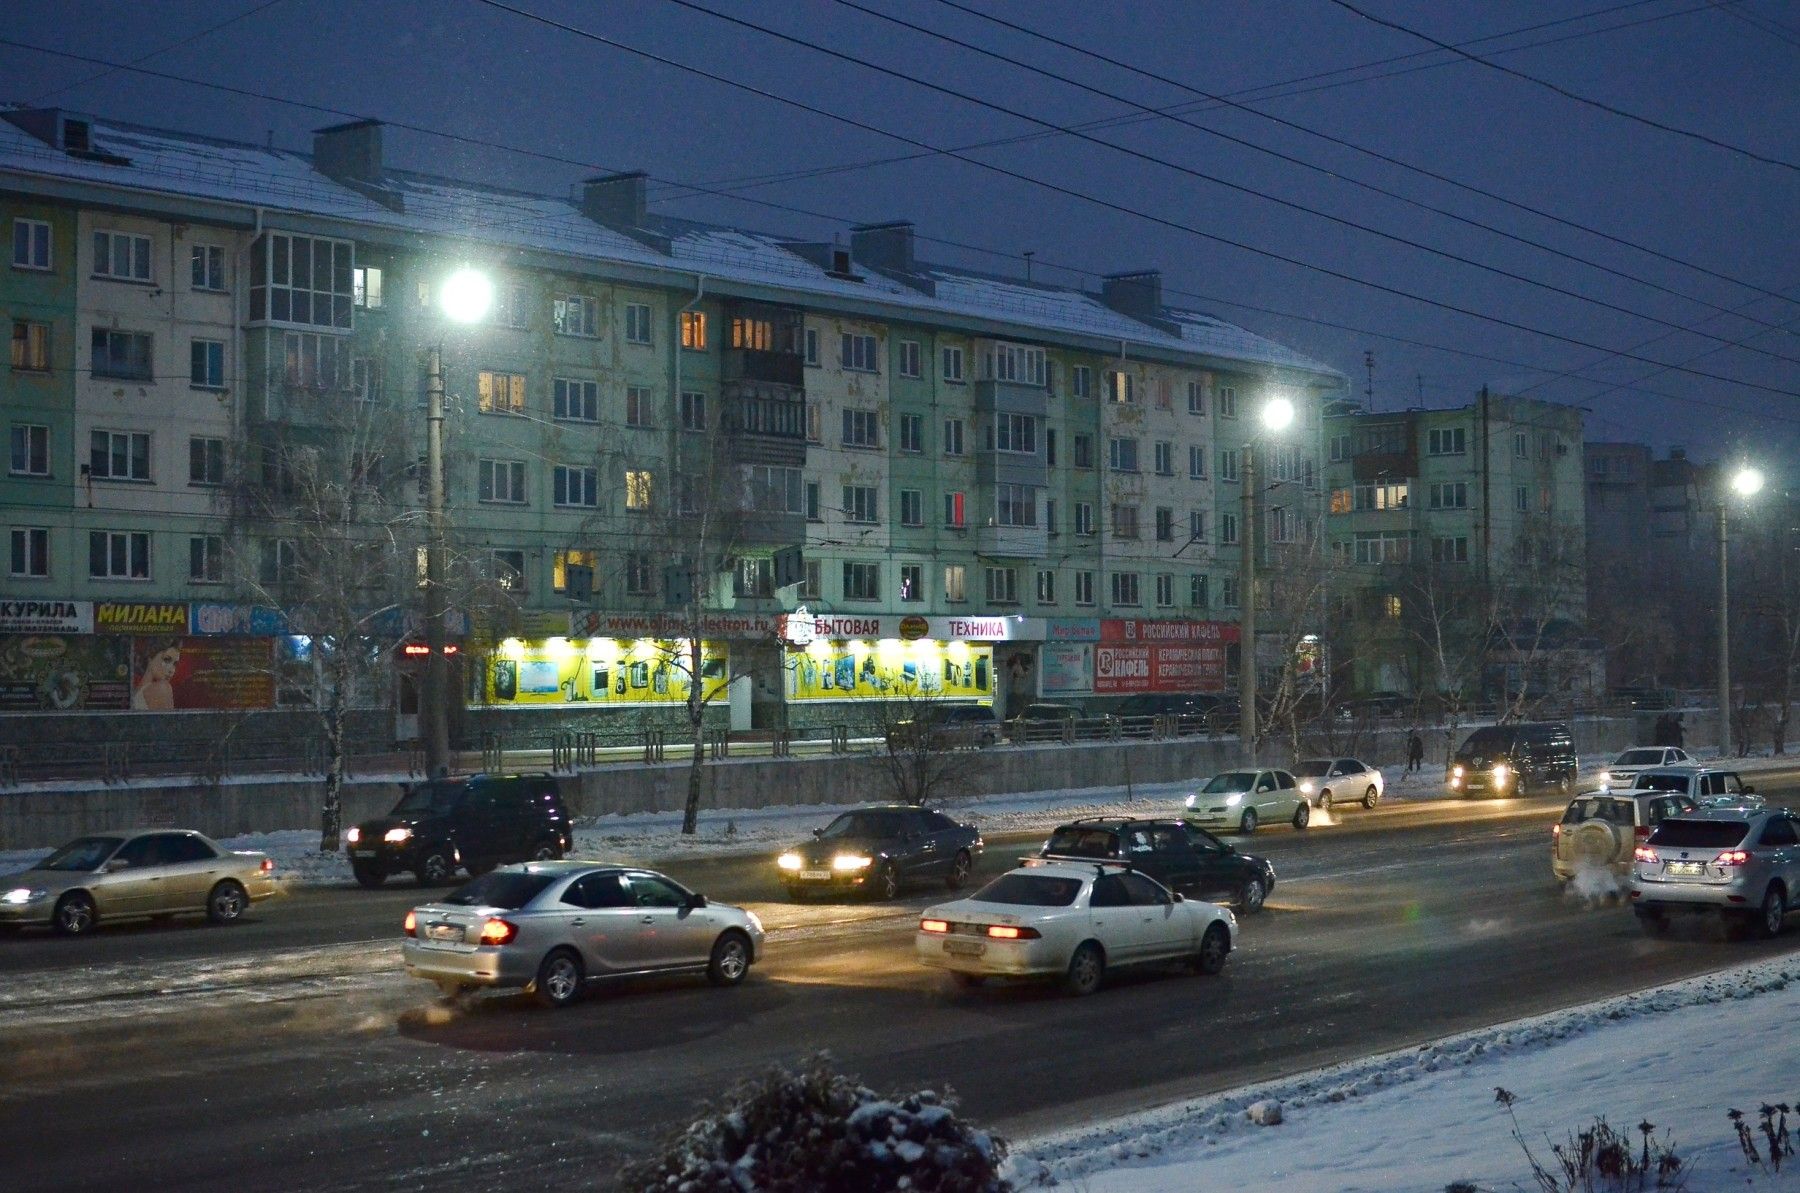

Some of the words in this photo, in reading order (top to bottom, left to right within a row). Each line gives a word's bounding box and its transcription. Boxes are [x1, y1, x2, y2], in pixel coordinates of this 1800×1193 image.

[97, 604, 186, 624] МИЛАНА
[814, 619, 880, 635] БЫТОВАЯ
[949, 620, 1004, 636] ТЕХНИКА
[1142, 622, 1190, 639] РОССИЙСКИЙ
[1191, 624, 1221, 639] КАФЕЛЬ
[1115, 646, 1150, 659] РОССИЙСКИЙ
[1115, 659, 1150, 677] КАФЕЛЬ
